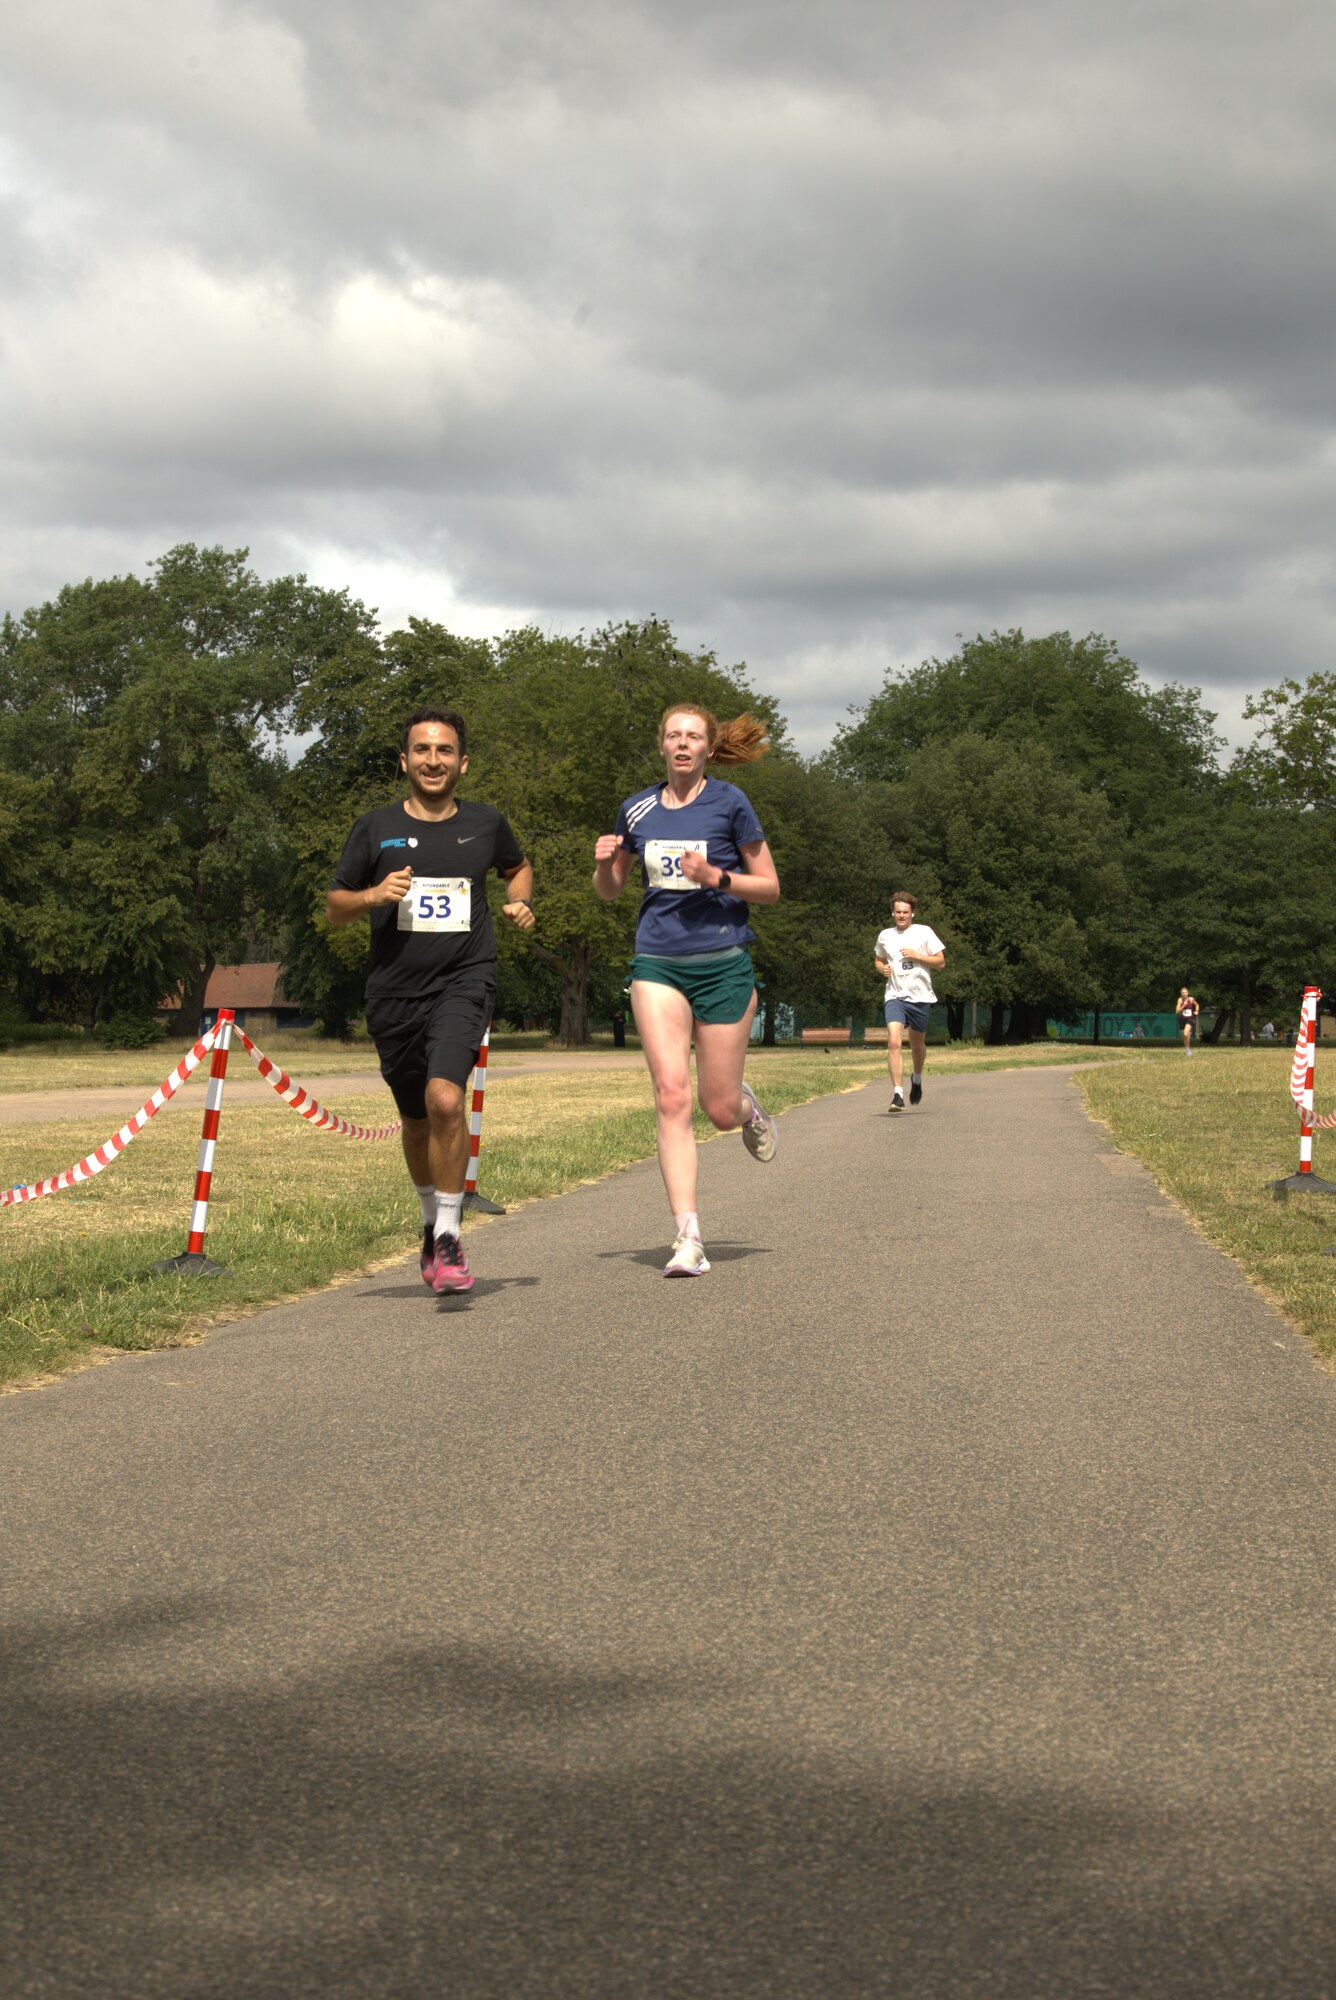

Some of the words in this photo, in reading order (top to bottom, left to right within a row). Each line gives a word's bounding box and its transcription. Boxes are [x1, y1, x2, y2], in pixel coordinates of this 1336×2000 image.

[660, 856, 684, 878] 39
[418, 895, 452, 919] 53
[902, 961, 914, 971] 63
